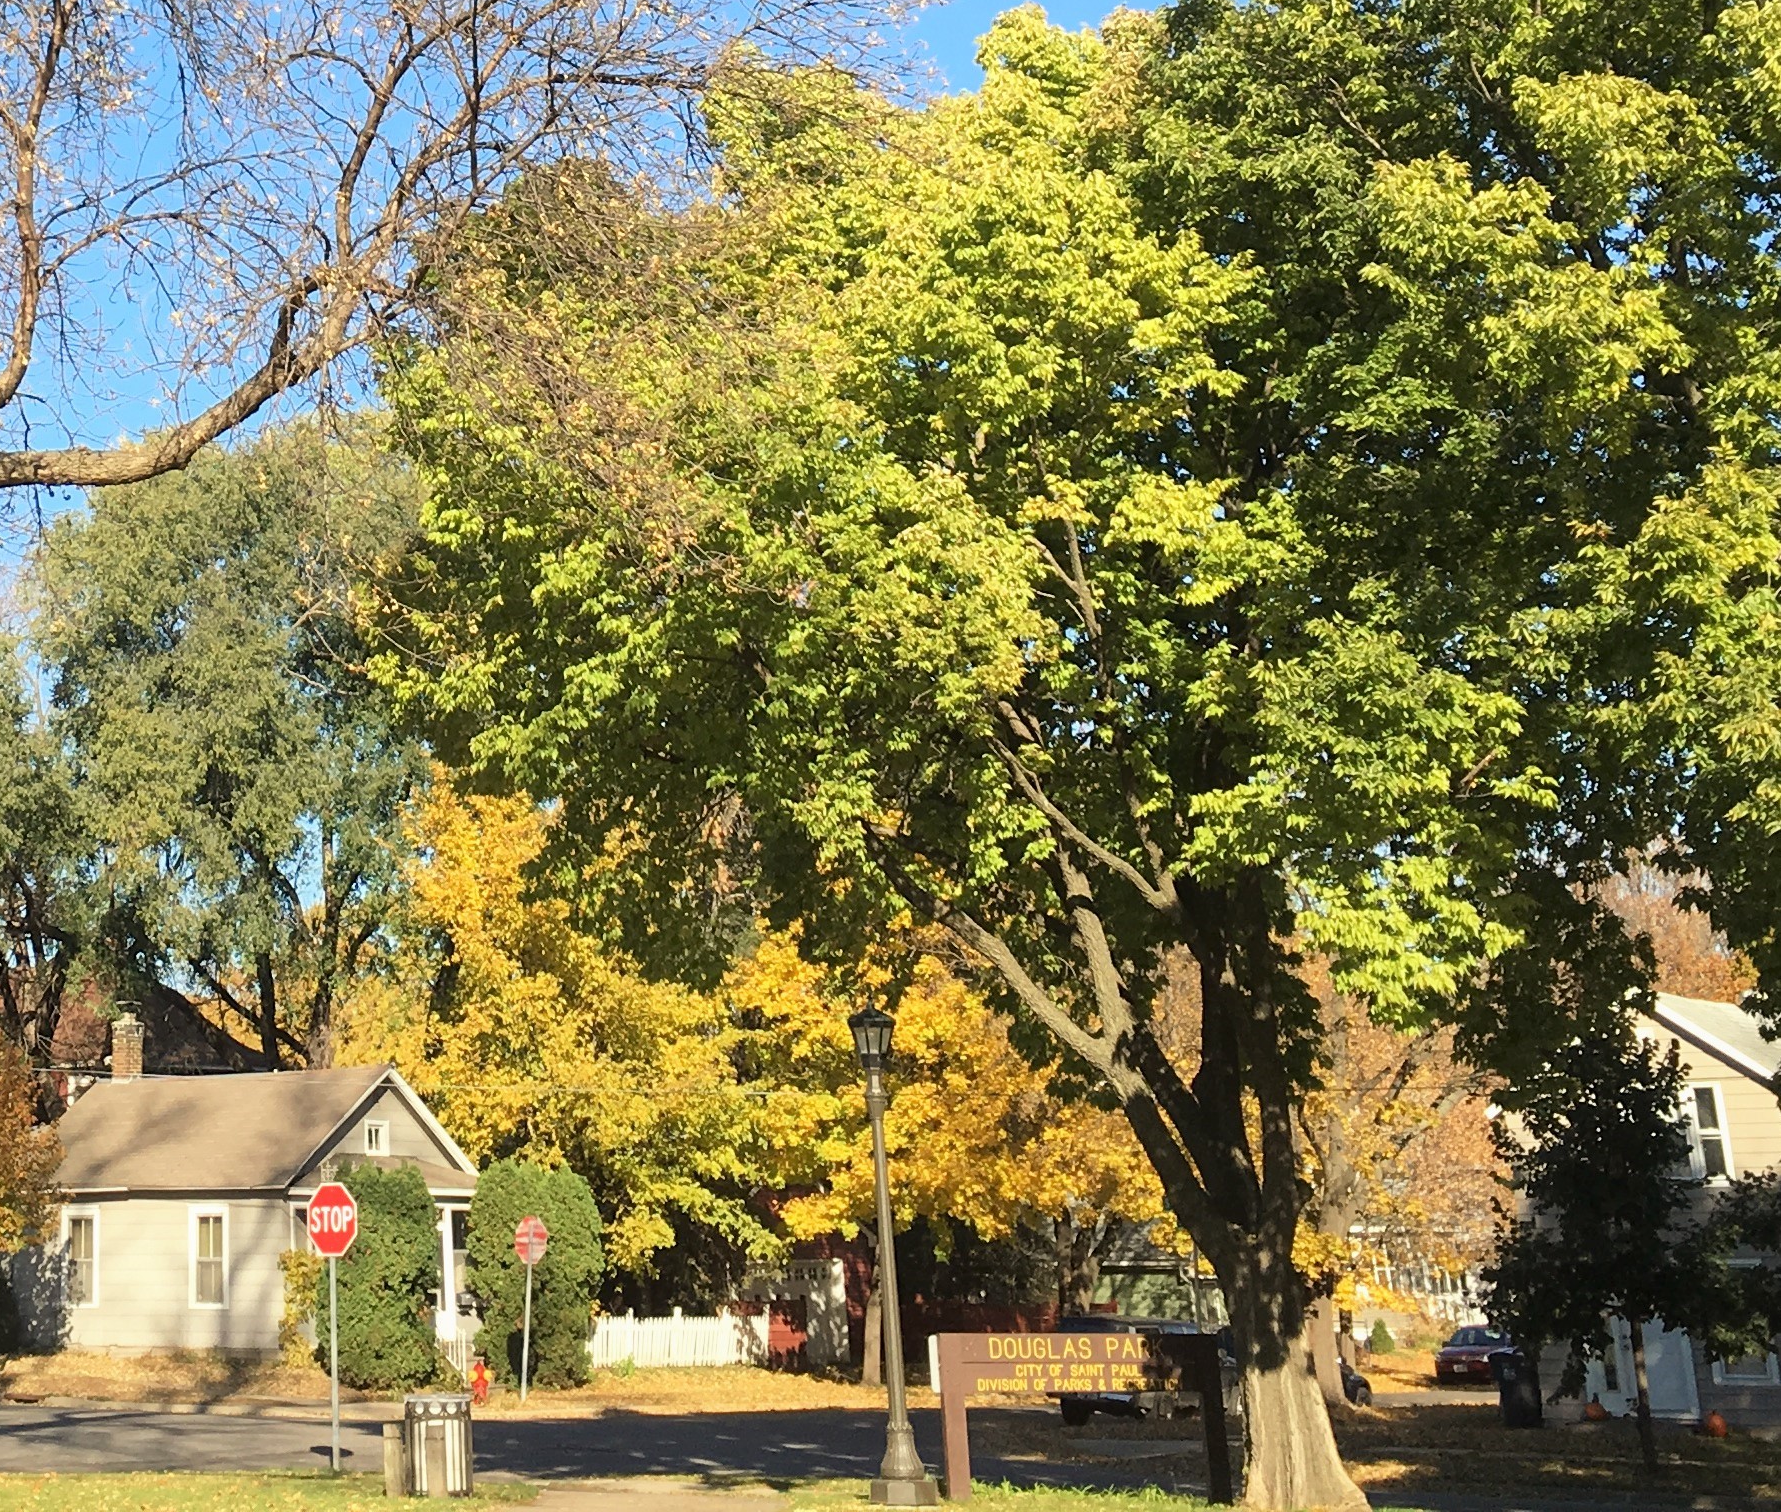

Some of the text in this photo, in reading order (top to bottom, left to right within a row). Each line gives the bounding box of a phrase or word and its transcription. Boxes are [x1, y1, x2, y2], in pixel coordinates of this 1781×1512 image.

[311, 1205, 353, 1233] STOP
[988, 1337, 1164, 1359] DOUGLAS PARK
[1015, 1364, 1143, 1377] CITY OF SAINT PAUL
[977, 1378, 1028, 1391] DIVISION
[1033, 1378, 1048, 1391] OF
[1054, 1378, 1093, 1391] PARKS
[1098, 1378, 1107, 1391] &
